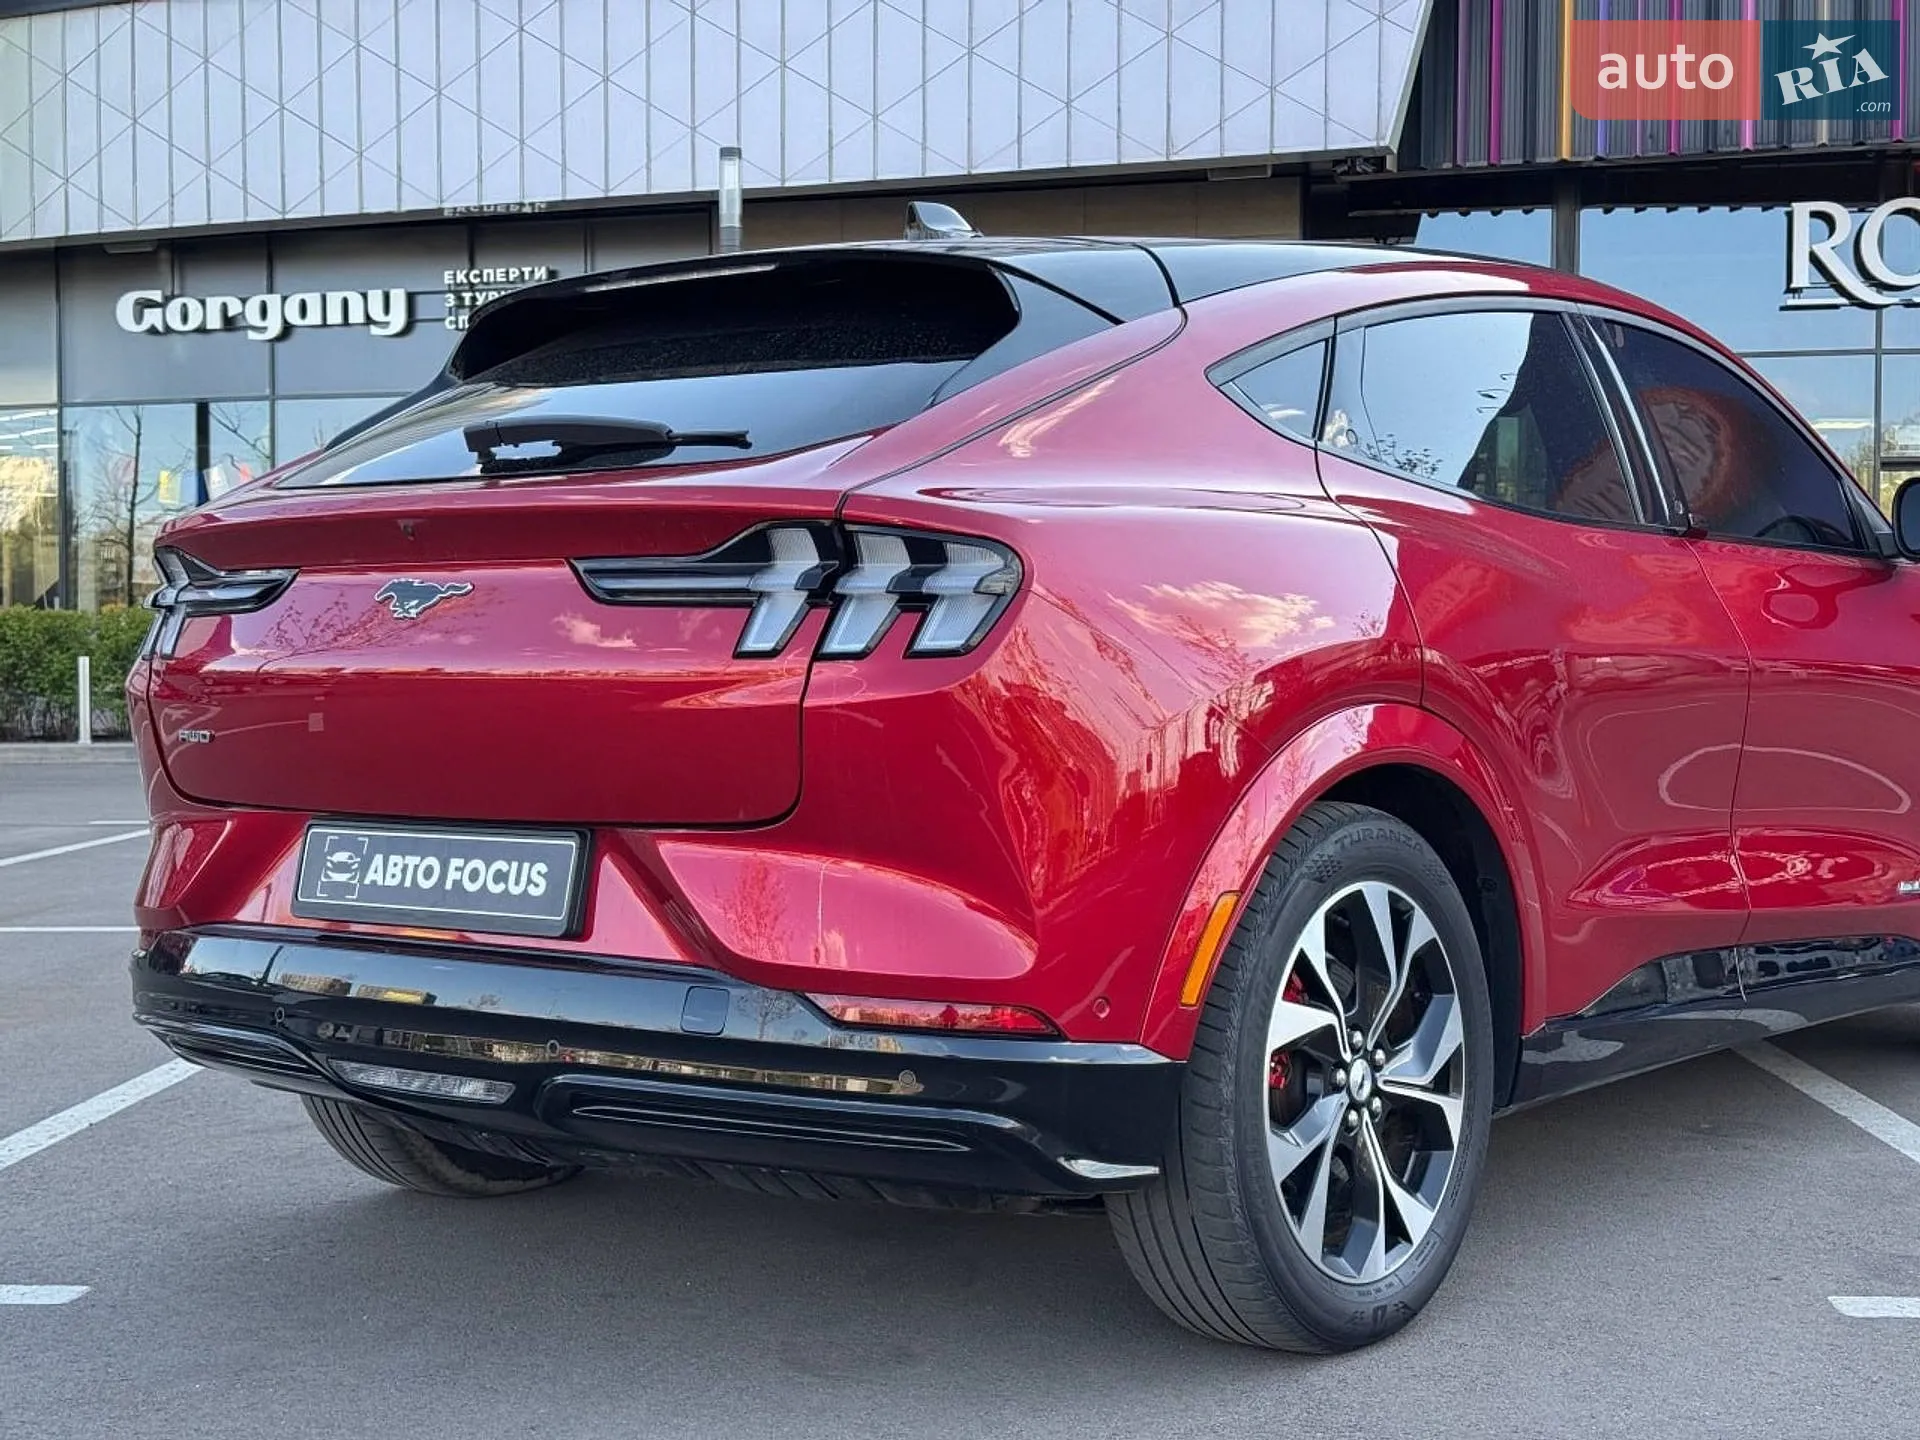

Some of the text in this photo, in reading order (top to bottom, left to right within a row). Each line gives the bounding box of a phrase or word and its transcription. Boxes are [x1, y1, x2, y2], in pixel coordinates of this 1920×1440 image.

[443, 266, 548, 284] ЕКСПЕРТИ
[461, 289, 520, 306] ТУР
[115, 288, 409, 341] Gorgany
[444, 857, 549, 897] FOCUS
